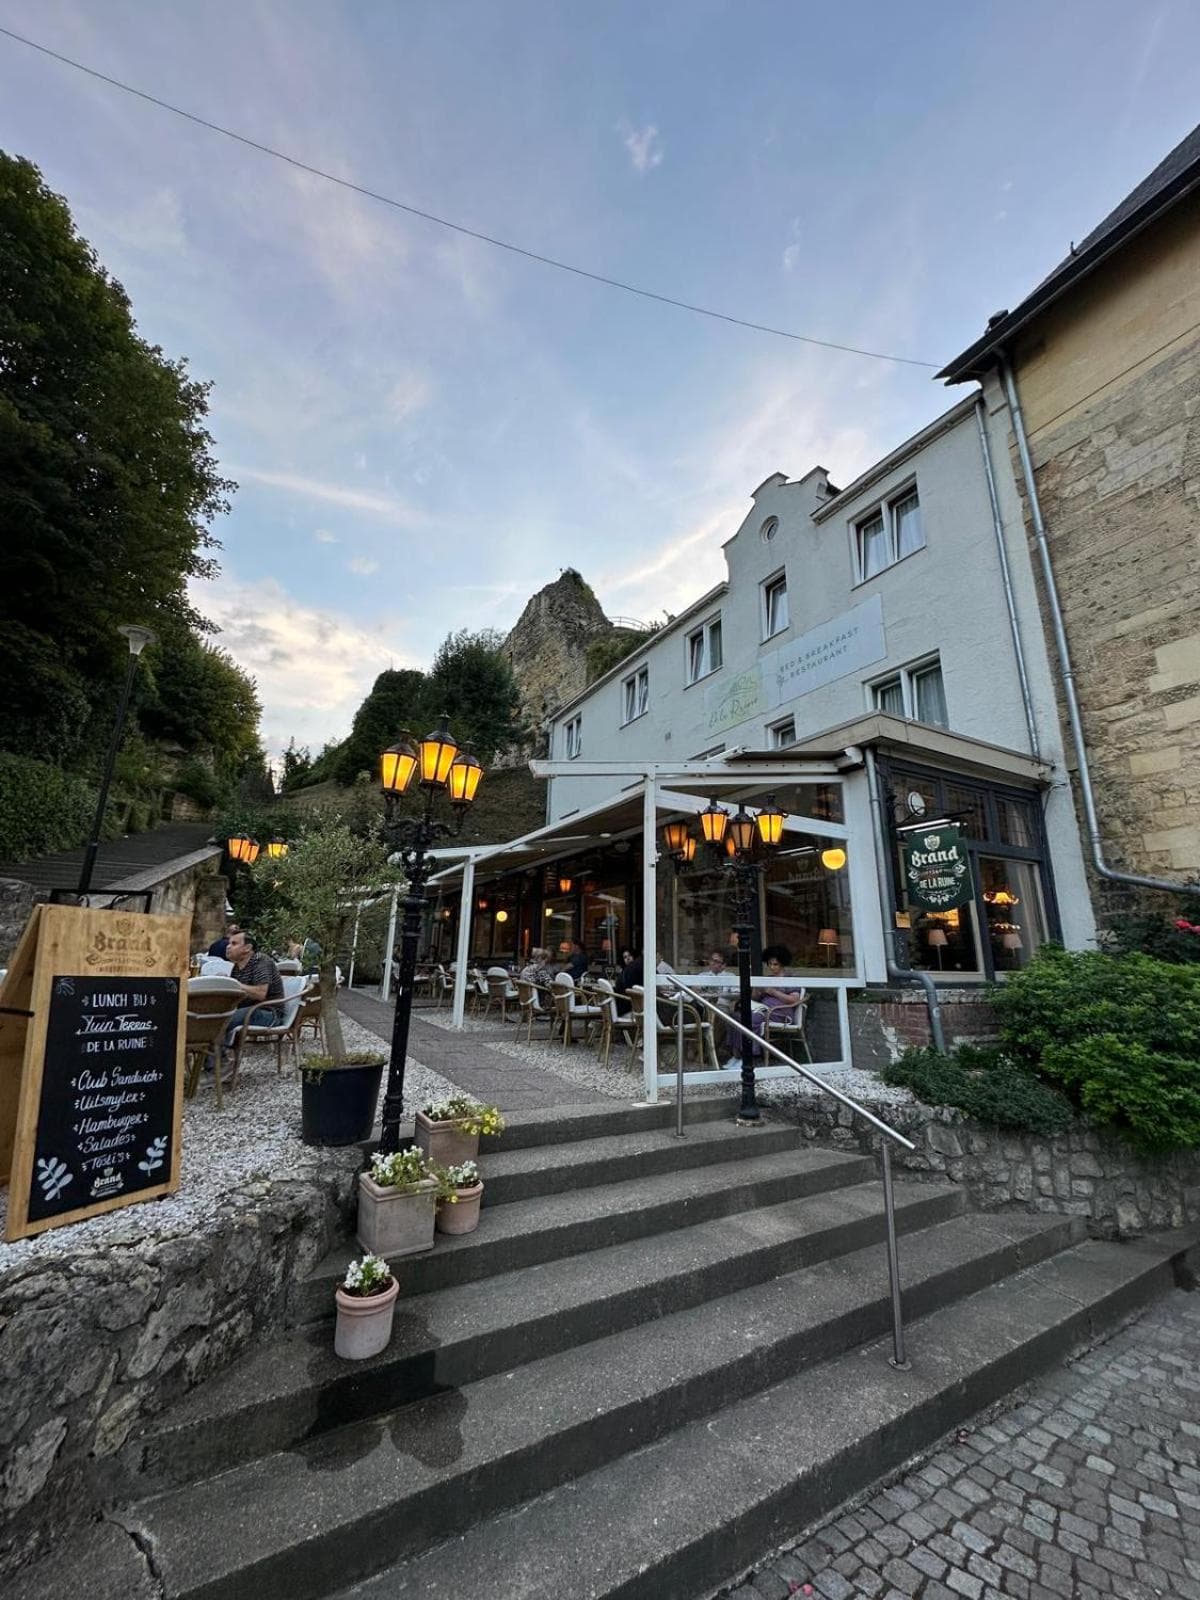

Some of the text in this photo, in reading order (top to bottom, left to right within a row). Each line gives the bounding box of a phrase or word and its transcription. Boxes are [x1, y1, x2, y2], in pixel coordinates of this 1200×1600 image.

[805, 626, 859, 660] BREAKFAST
[790, 644, 847, 678] RESTAURANT
[911, 845, 959, 868] Brand
[919, 877, 956, 889] DE LA RUINE
[94, 931, 151, 952] Brand
[92, 993, 147, 1008] LUNCH BIJ
[86, 1037, 147, 1053] DE LA RUINE
[78, 1066, 158, 1091] Club Sandwich
[79, 1113, 142, 1135] Hamburger
[83, 1134, 131, 1154] Salades
